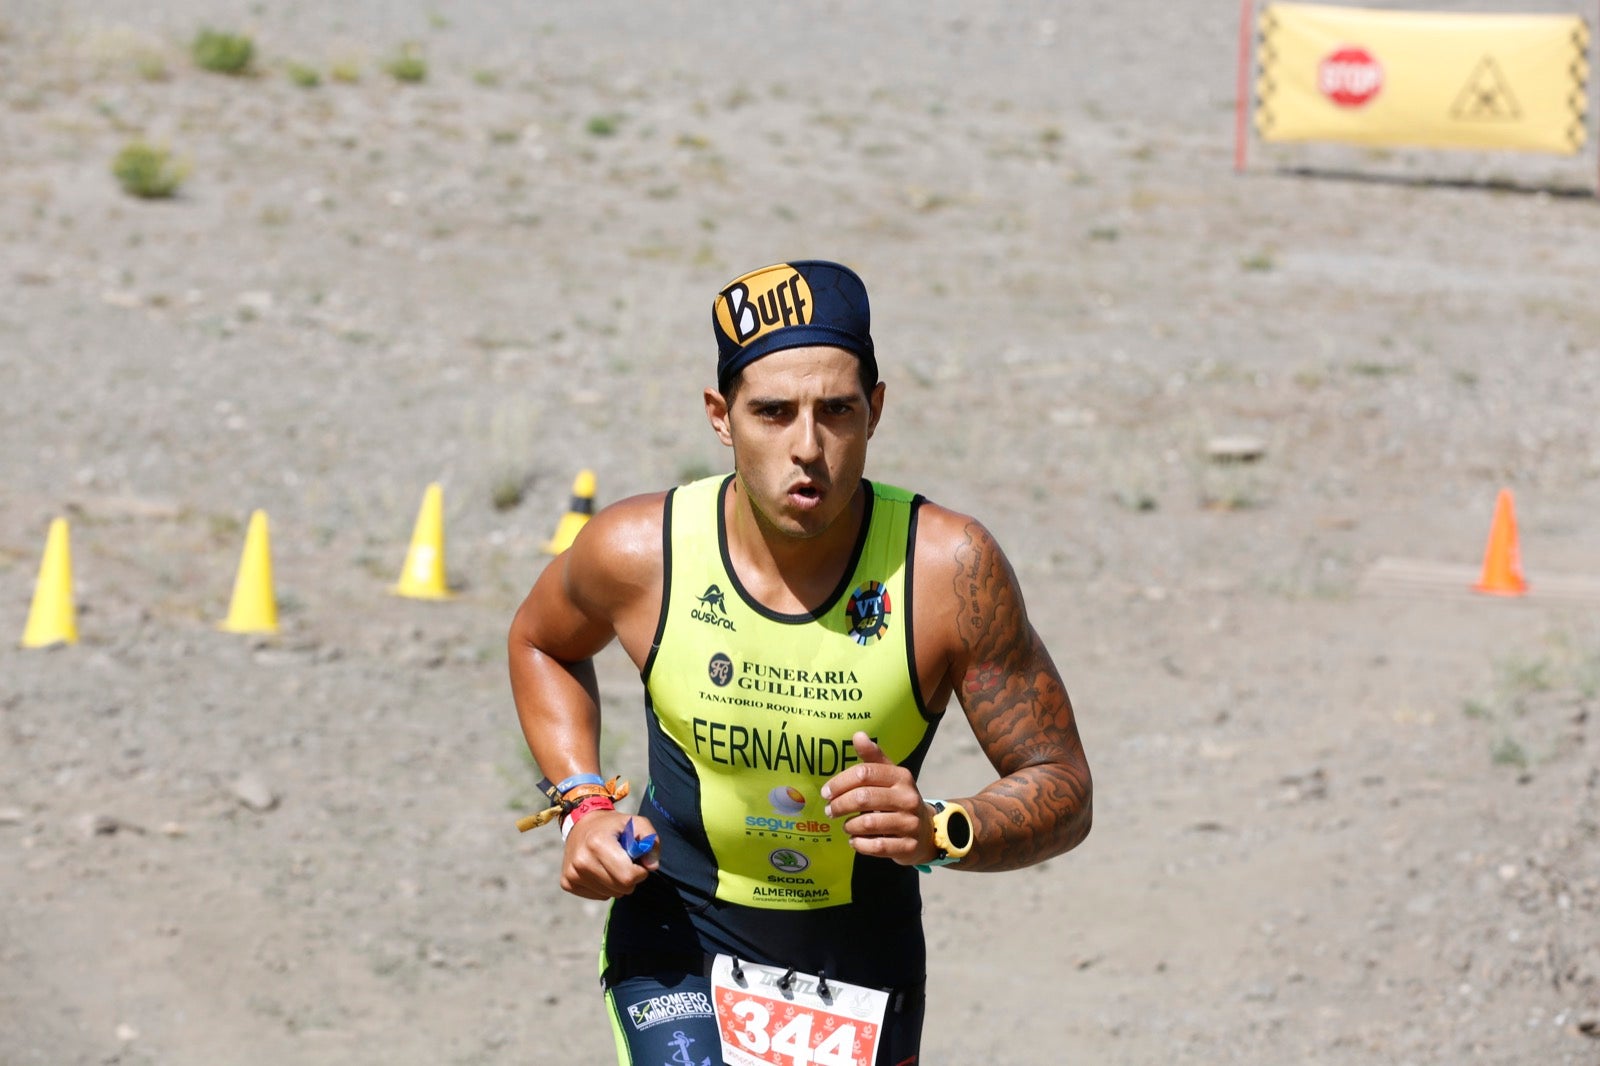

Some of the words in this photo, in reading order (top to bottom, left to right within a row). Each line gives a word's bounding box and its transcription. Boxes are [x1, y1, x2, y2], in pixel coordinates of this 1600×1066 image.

[1321, 63, 1380, 93] STOP
[856, 595, 881, 618] VT
[690, 609, 736, 632] austral
[742, 661, 858, 684] FUNERARIA
[738, 677, 863, 701] GUILLERMO
[699, 691, 764, 708] TANATORIO
[766, 702, 826, 719] ROQUETAS
[829, 711, 844, 720] DE
[847, 711, 872, 720] MAR
[692, 717, 878, 777] FERNÁNDE
[745, 816, 830, 832] segurelite
[745, 831, 832, 843] SEGUROS
[753, 886, 829, 898] ALMERIGAMA
[650, 992, 707, 1008] ROMERO
[655, 1001, 712, 1019] MORENO
[732, 1000, 858, 1066] 344
